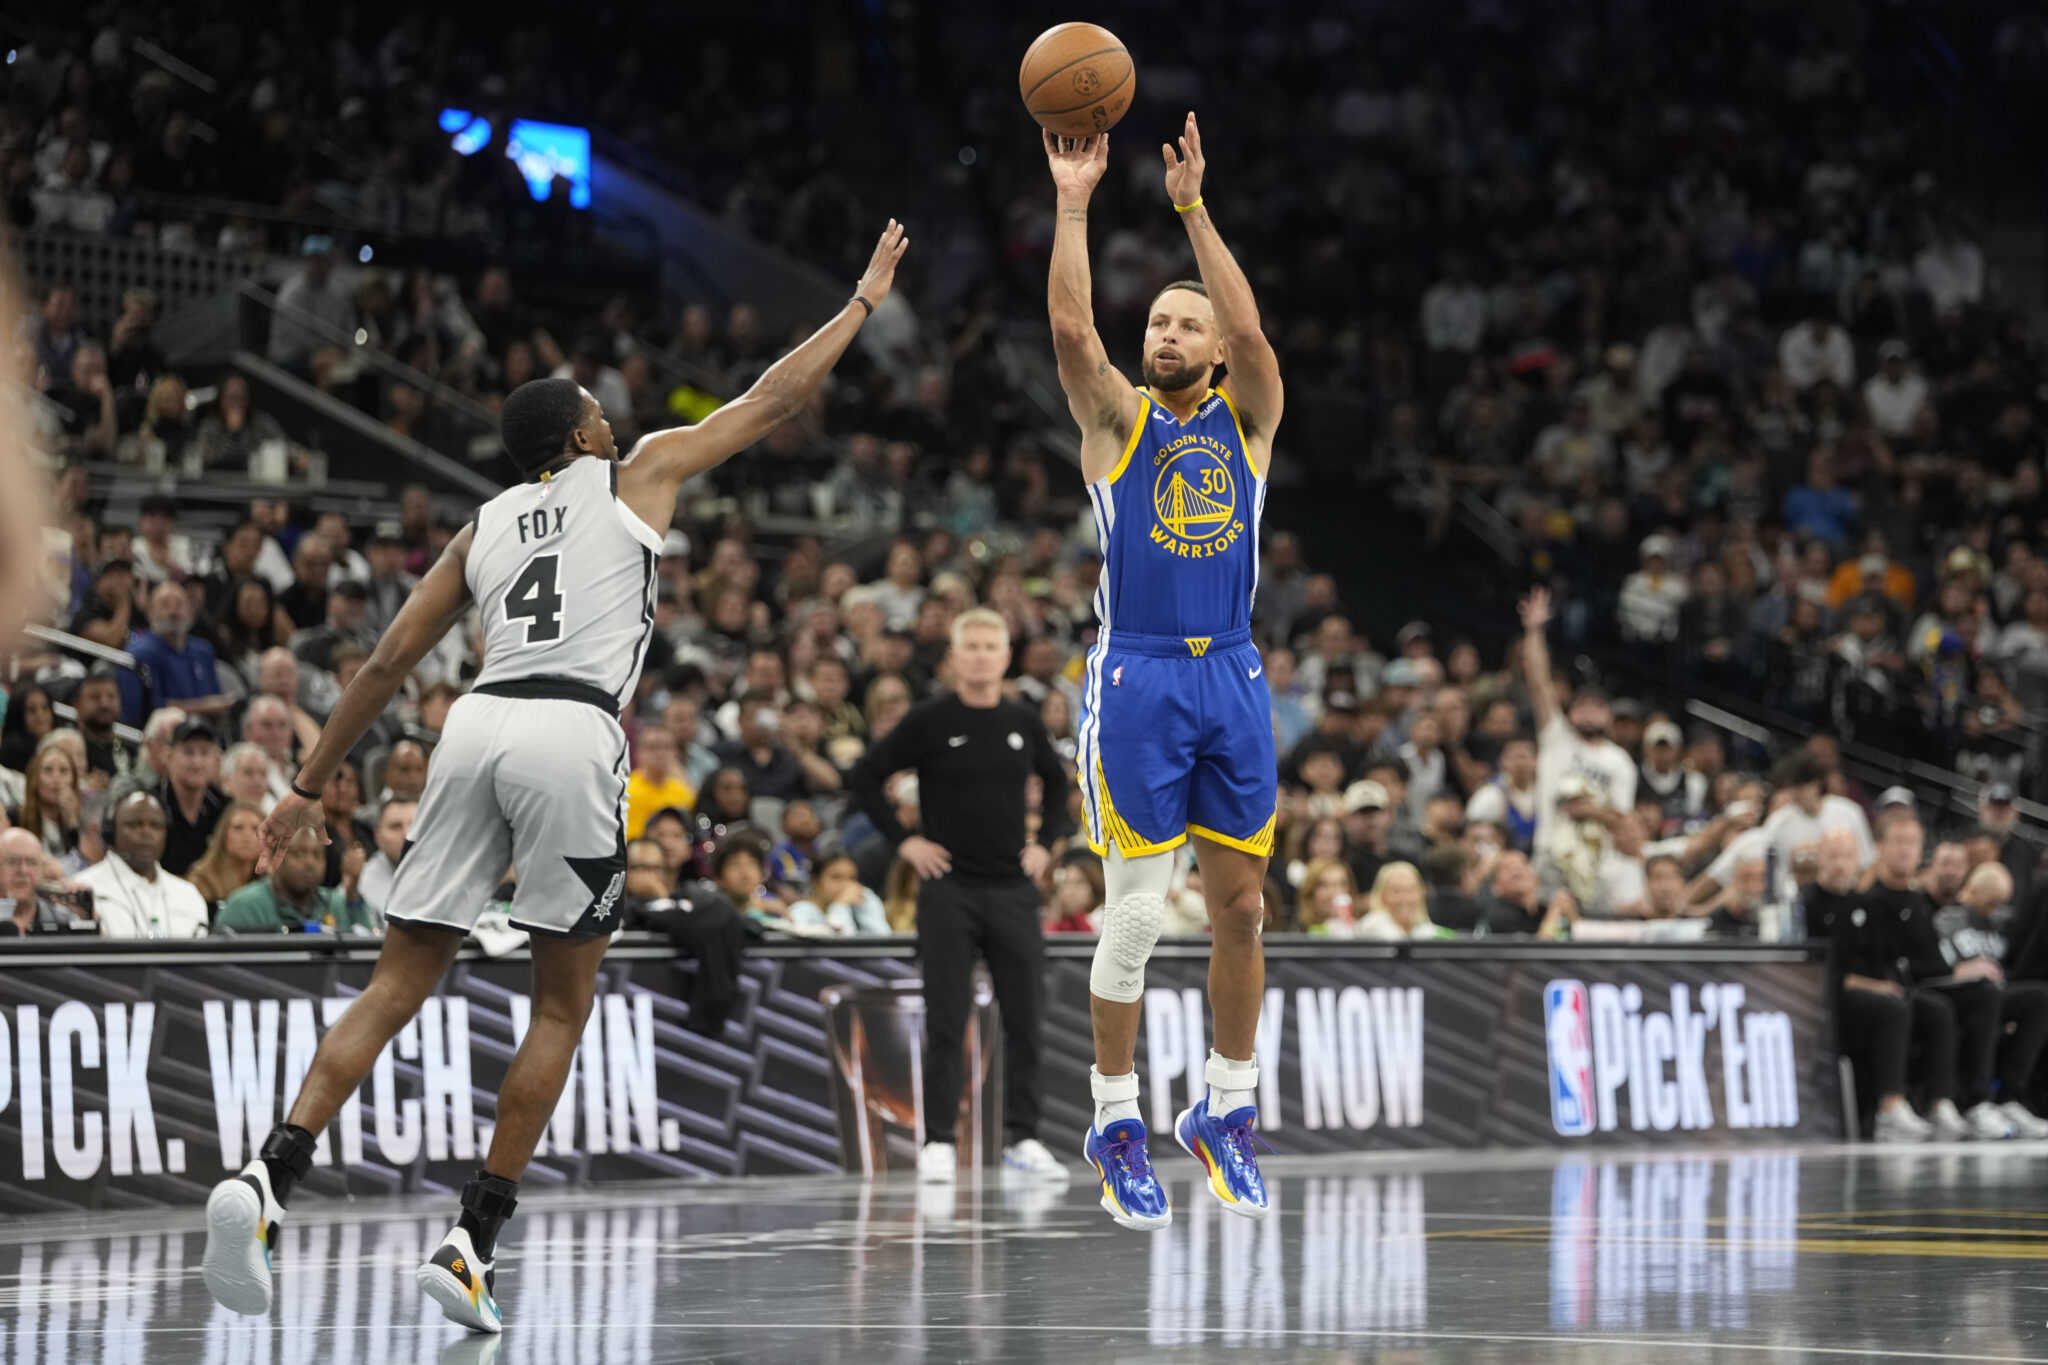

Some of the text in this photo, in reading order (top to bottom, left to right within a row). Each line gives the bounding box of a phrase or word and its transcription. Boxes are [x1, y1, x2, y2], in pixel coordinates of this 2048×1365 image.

[1153, 434, 1232, 466] GOLDEN STATE
[1200, 467, 1227, 495] 30
[517, 506, 568, 544] FOX
[1149, 519, 1244, 559] WARRIORS
[501, 550, 567, 647] 4
[0, 1000, 187, 1181] ICK.
[1145, 985, 1425, 1136] PLY NOW
[1590, 981, 1800, 1132] Pick'Em
